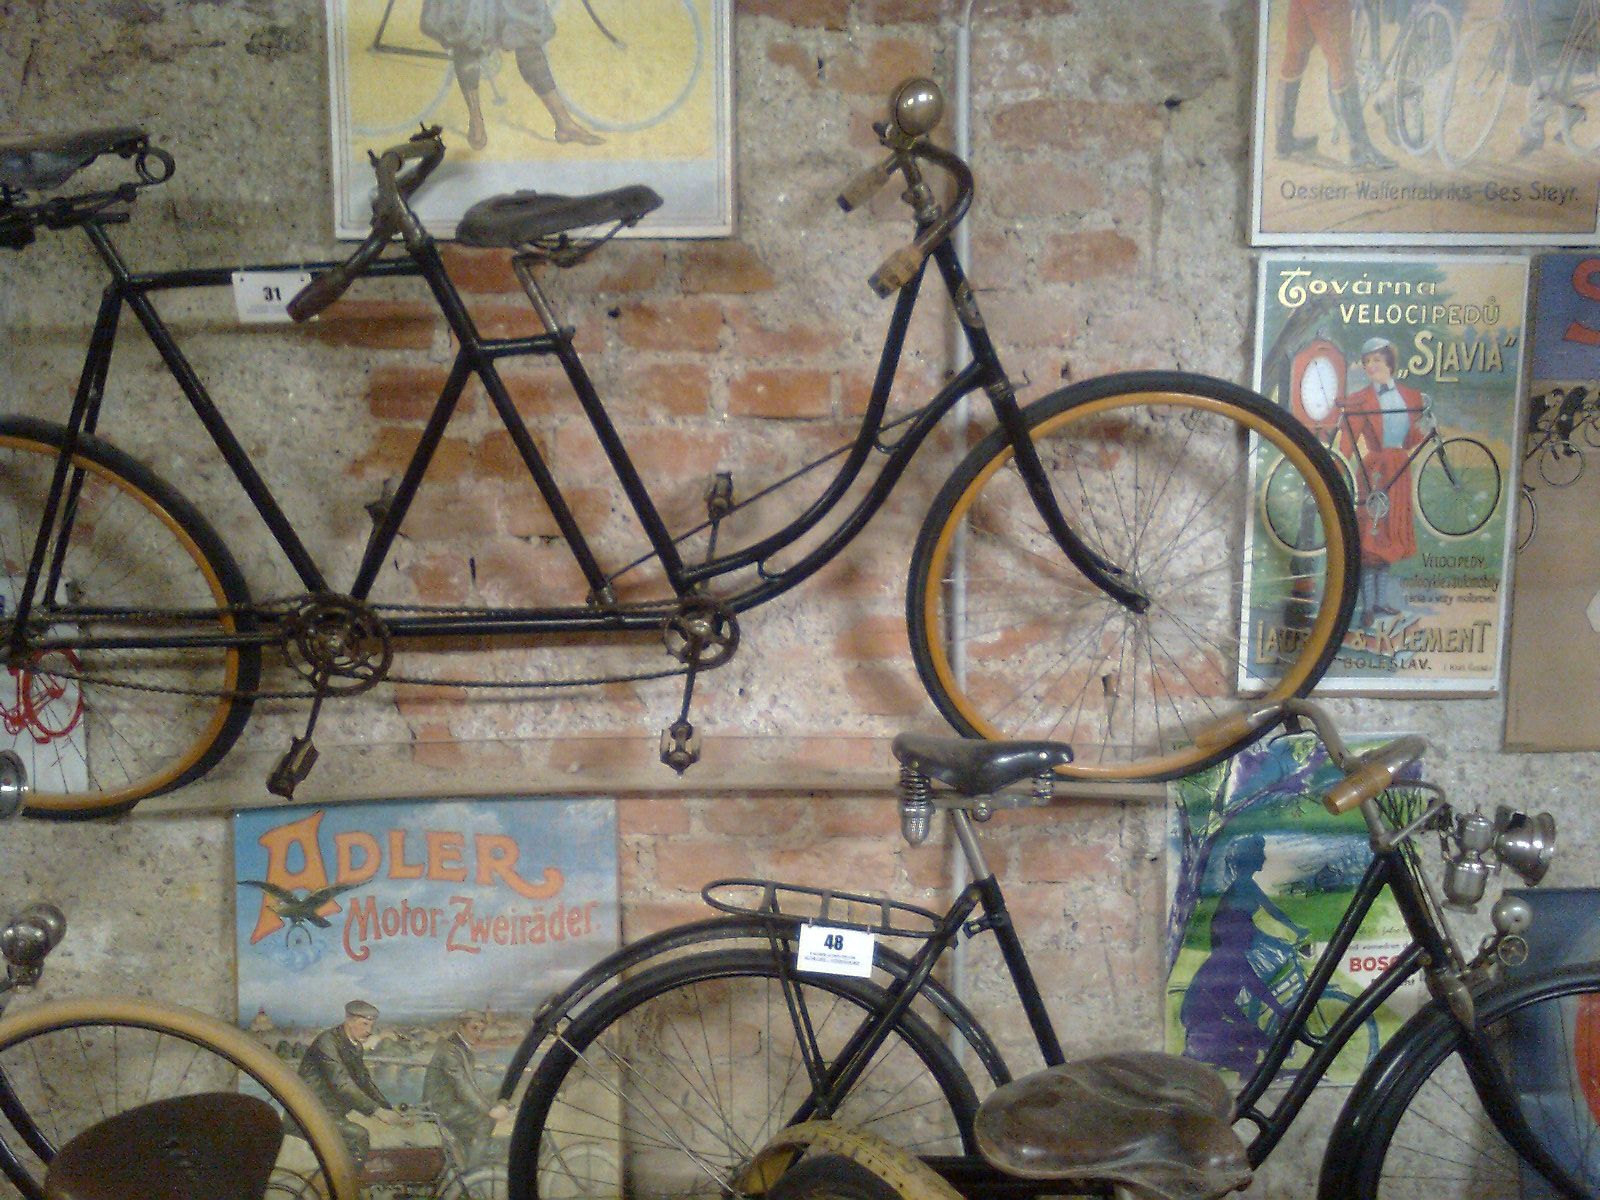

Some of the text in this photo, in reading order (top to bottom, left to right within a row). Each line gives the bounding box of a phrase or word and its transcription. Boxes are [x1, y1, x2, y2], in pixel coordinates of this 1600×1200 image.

[263, 286, 281, 302] 31
[1278, 267, 1436, 308] Továrna
[1340, 296, 1501, 326] VELOCIPEDŮ
[1375, 617, 1492, 655] KLEMENT
[250, 809, 565, 945] ADLER
[824, 934, 844, 950] 48
[1350, 955, 1399, 972] BOS
